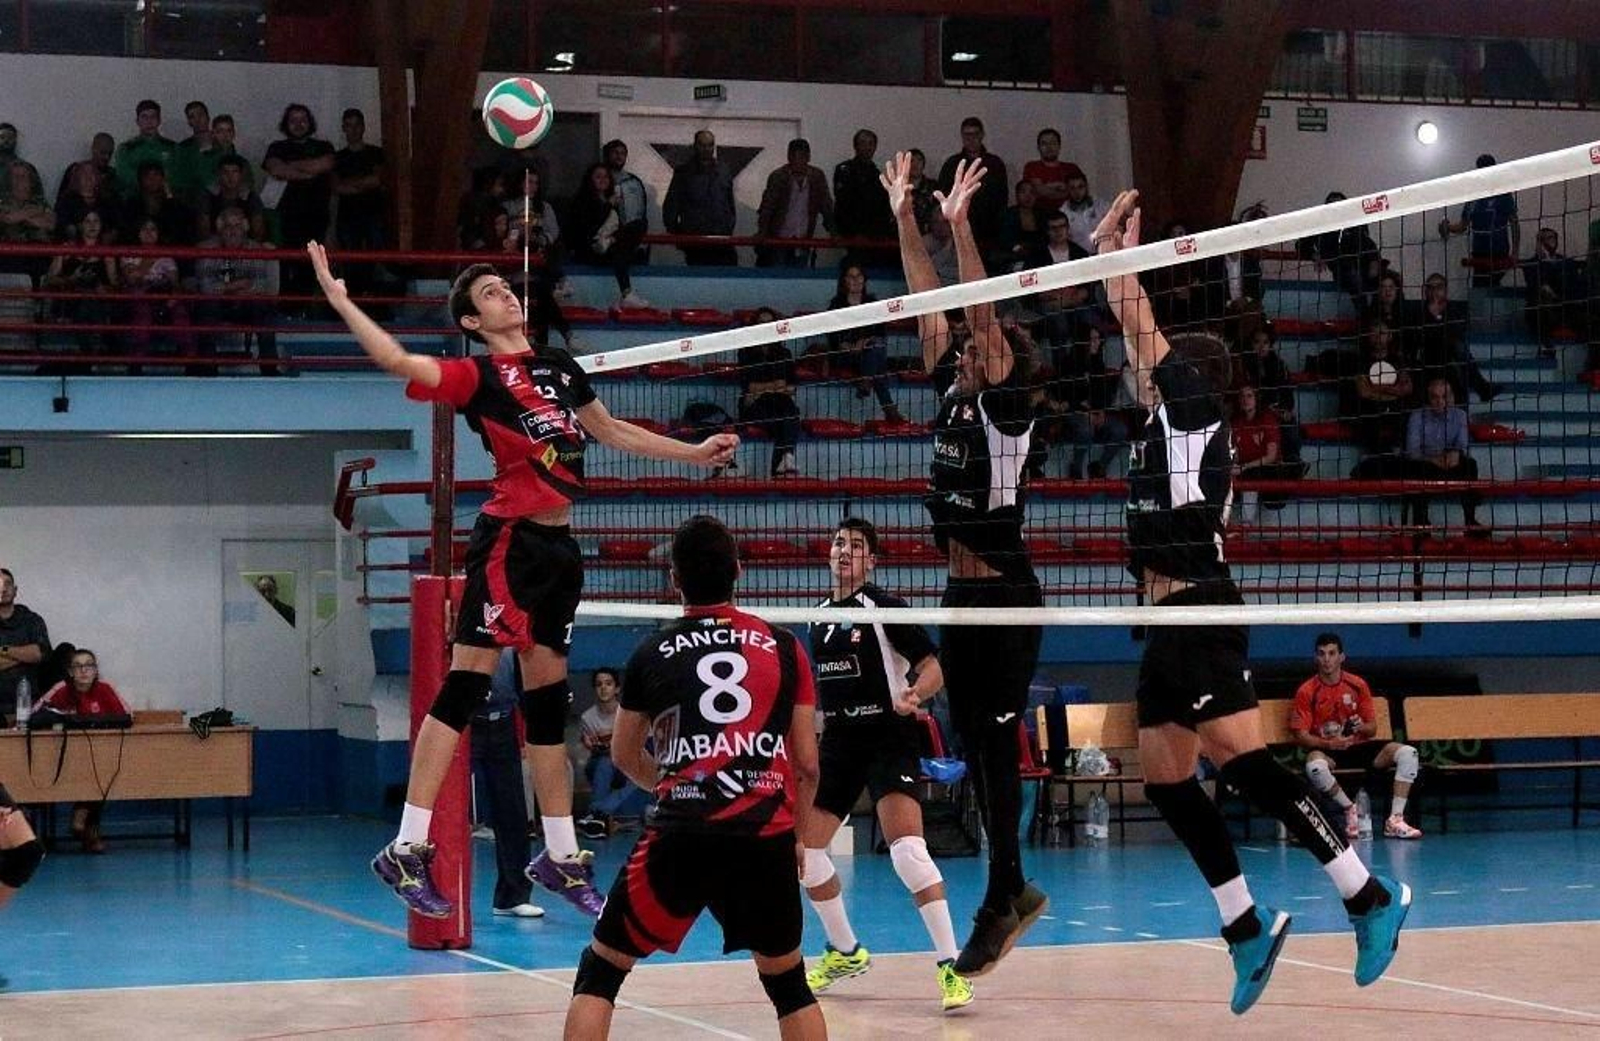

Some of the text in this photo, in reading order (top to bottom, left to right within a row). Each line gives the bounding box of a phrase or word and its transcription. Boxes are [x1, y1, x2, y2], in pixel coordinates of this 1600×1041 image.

[533, 385, 559, 400] 12
[936, 442, 960, 459] TASA
[658, 629, 777, 658] SANCHEZ
[817, 660, 852, 673] INTASA
[696, 651, 752, 724] 8
[677, 731, 787, 763] ABANCA
